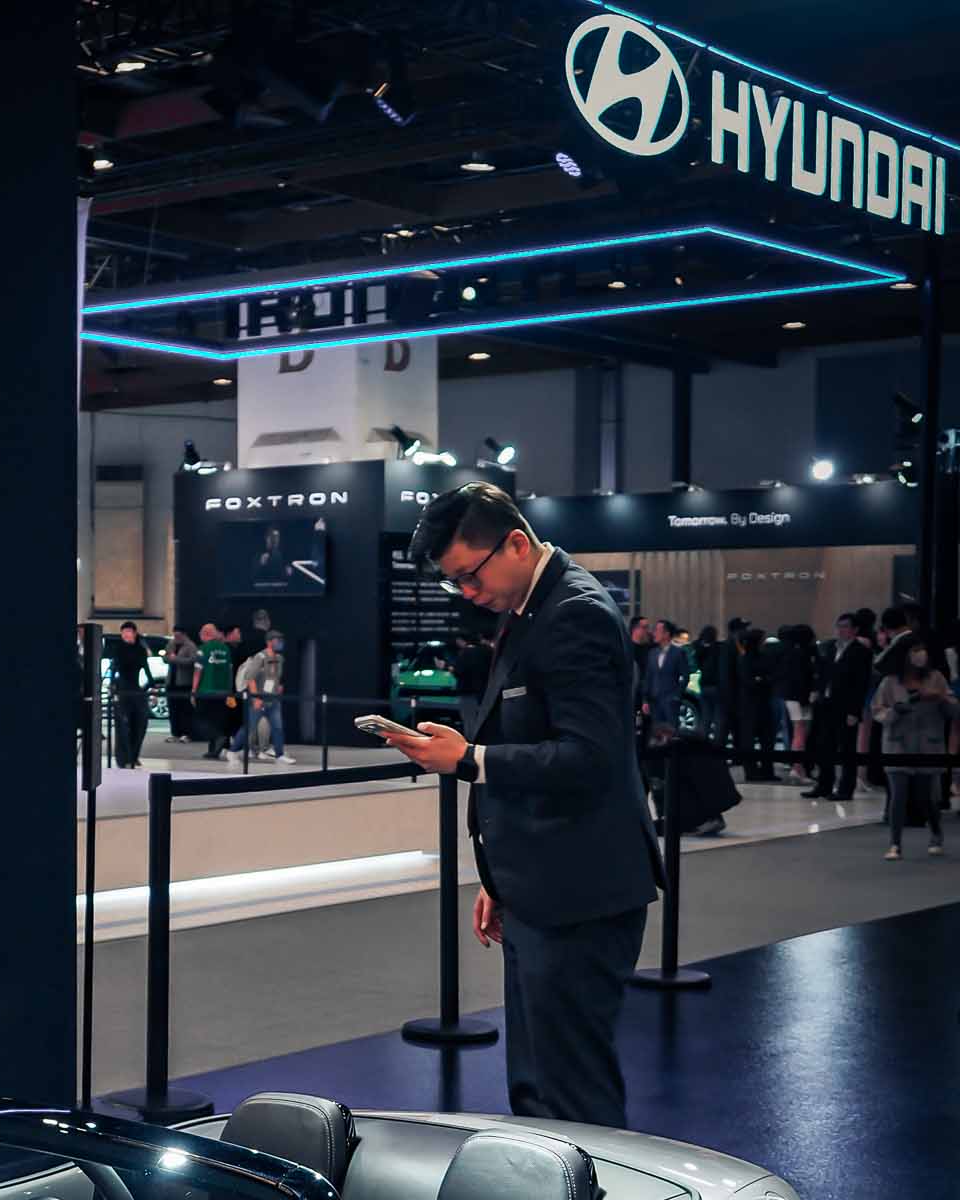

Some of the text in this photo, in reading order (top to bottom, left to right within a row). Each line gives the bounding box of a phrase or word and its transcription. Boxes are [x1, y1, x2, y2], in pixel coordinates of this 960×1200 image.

[711, 69, 946, 236] HYUNDAI
[205, 491, 349, 511] FOXTRON
[730, 512, 746, 527] By
[749, 512, 791, 526] Design
